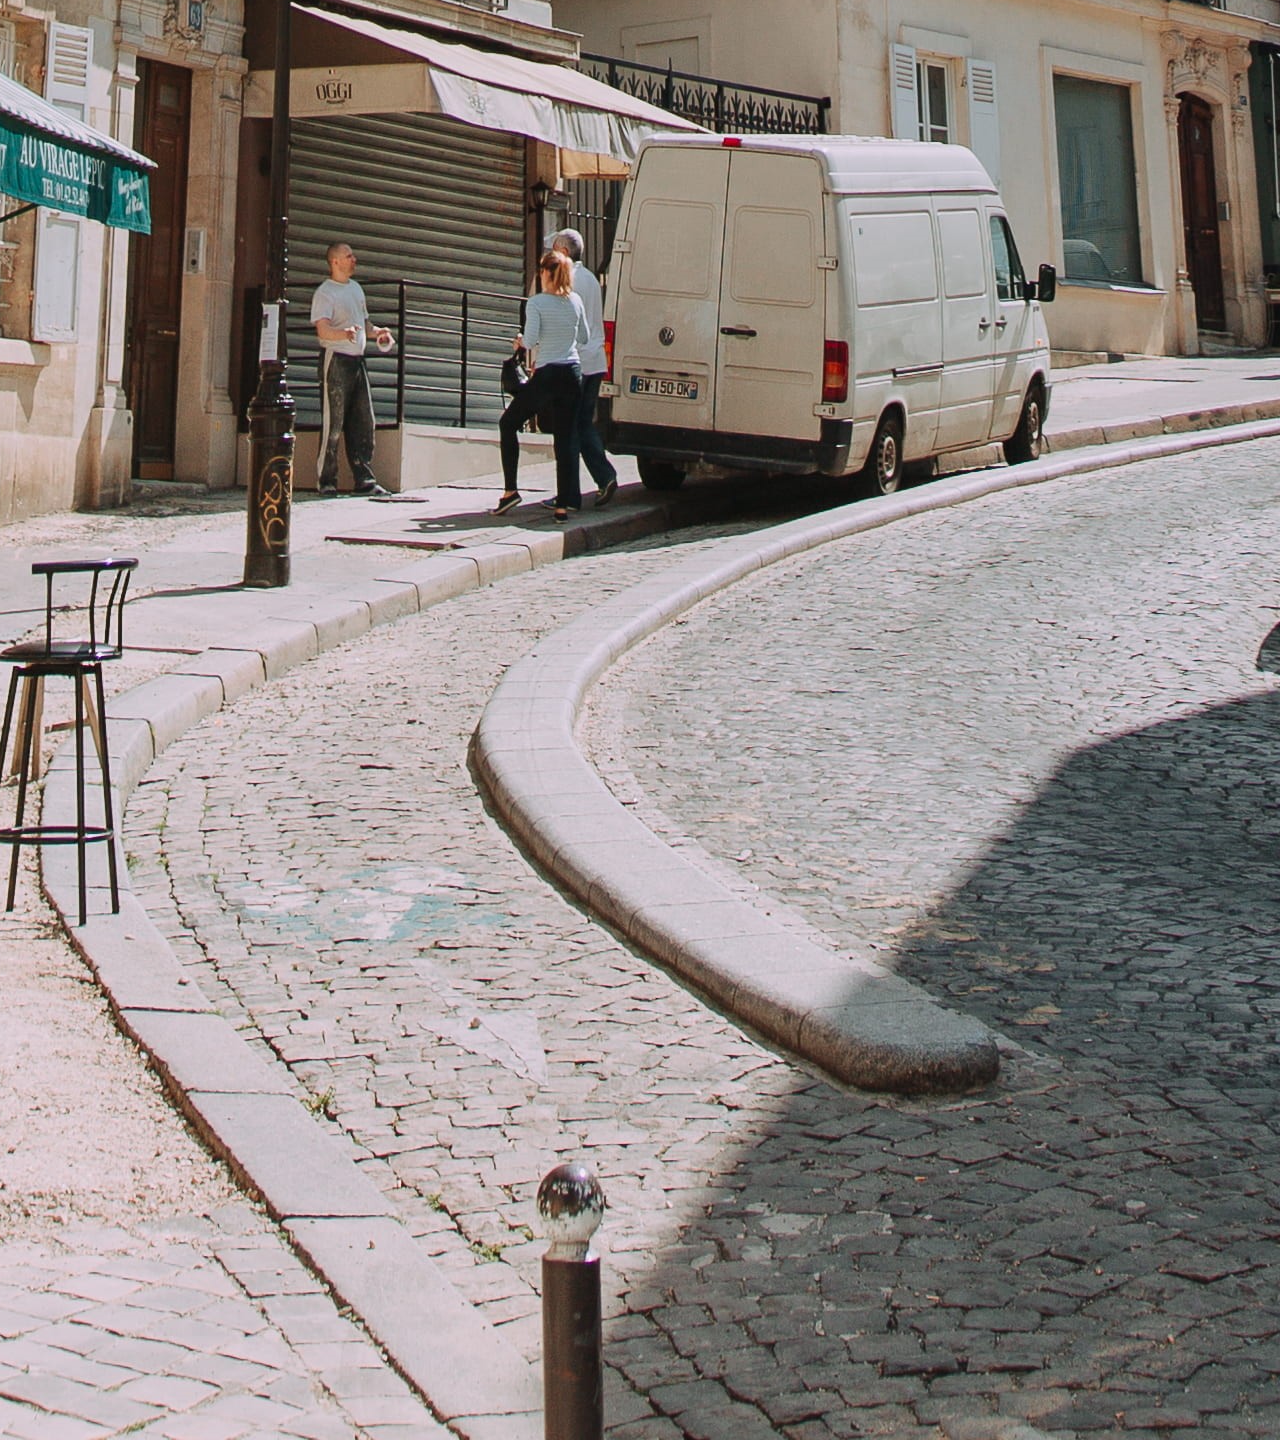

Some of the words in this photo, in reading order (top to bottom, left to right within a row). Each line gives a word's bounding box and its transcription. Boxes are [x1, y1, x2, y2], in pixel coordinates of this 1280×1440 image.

[316, 83, 352, 101] OGGI
[20, 133, 38, 168] AU
[39, 140, 80, 181] VIRAGE
[80, 153, 106, 190] LEPIC
